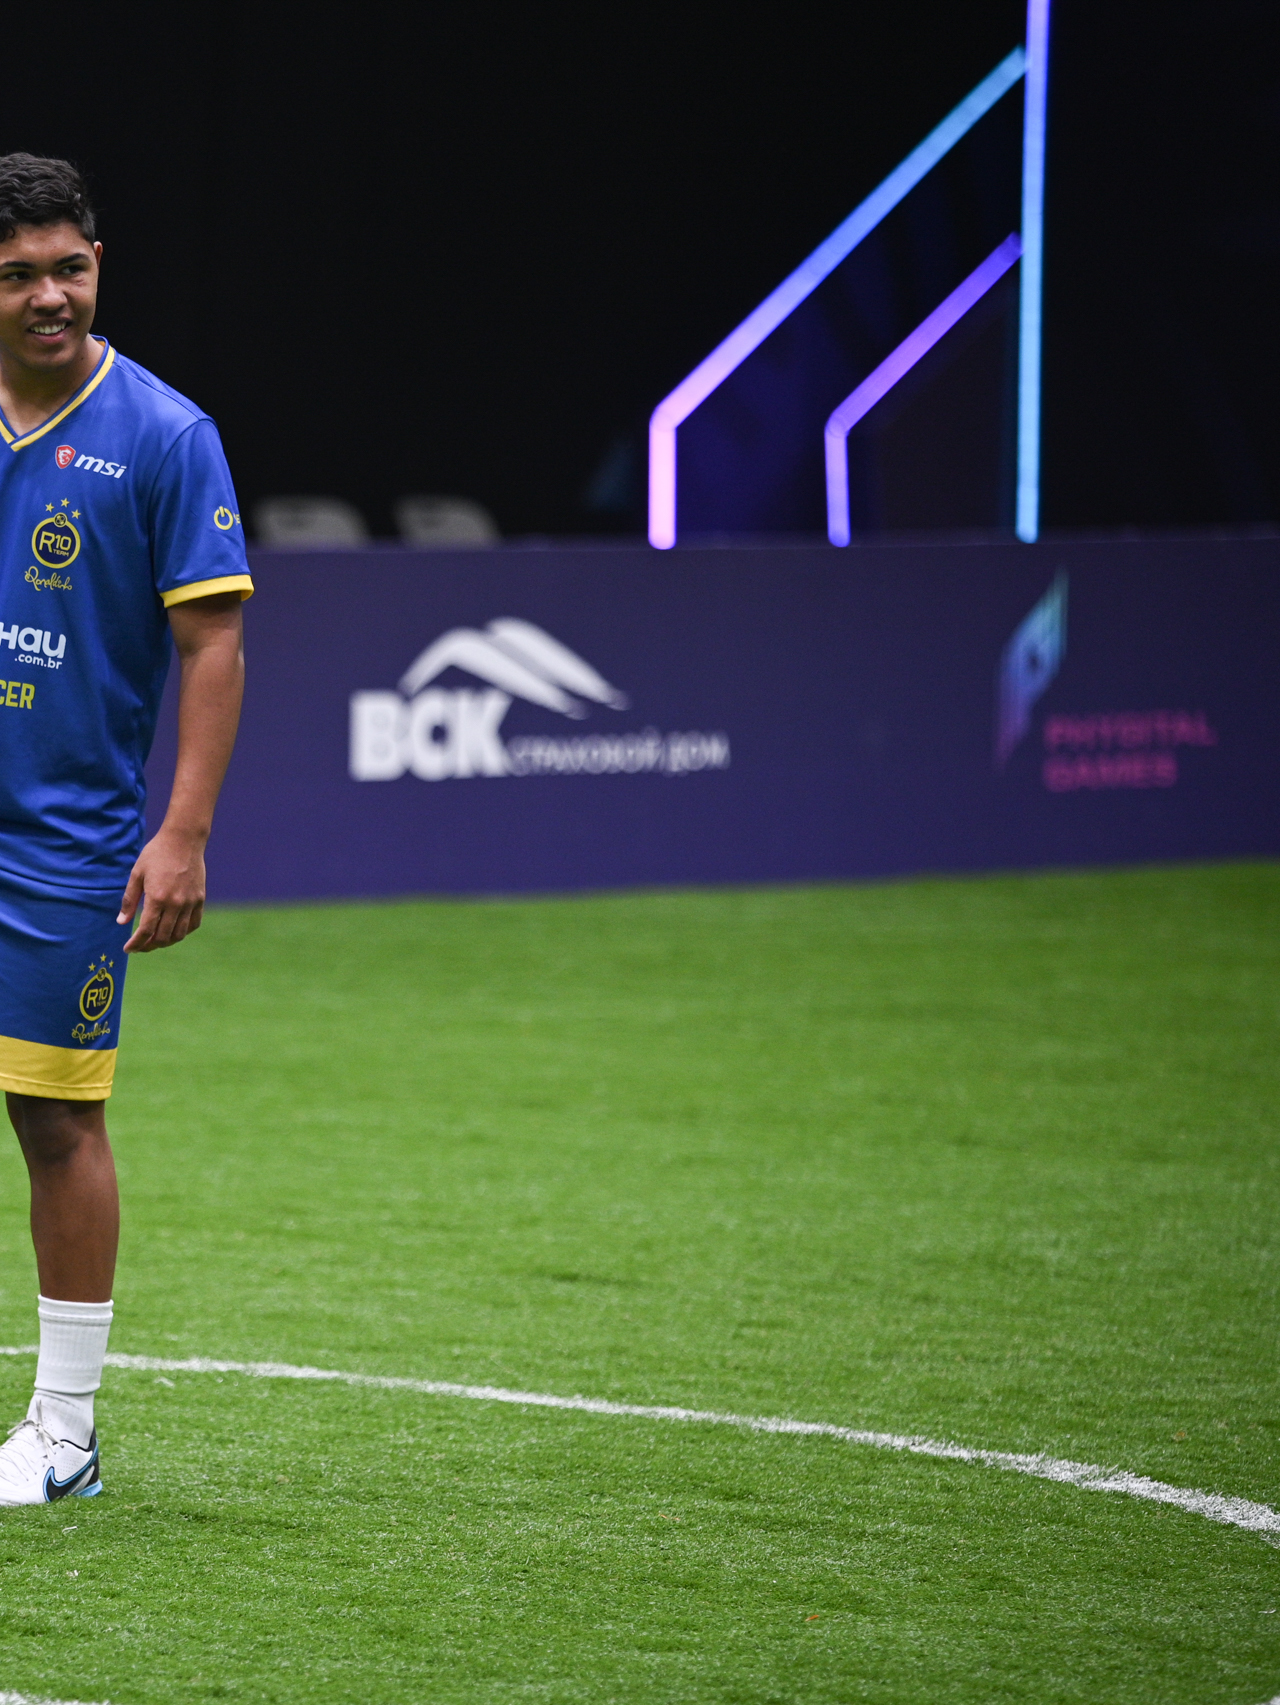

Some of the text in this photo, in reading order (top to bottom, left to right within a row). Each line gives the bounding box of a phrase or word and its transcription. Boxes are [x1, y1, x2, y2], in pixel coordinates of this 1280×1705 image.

[74, 454, 127, 479] msi
[39, 531, 72, 553] R10
[14, 653, 63, 669] .com.br
[86, 986, 109, 1008] R10
